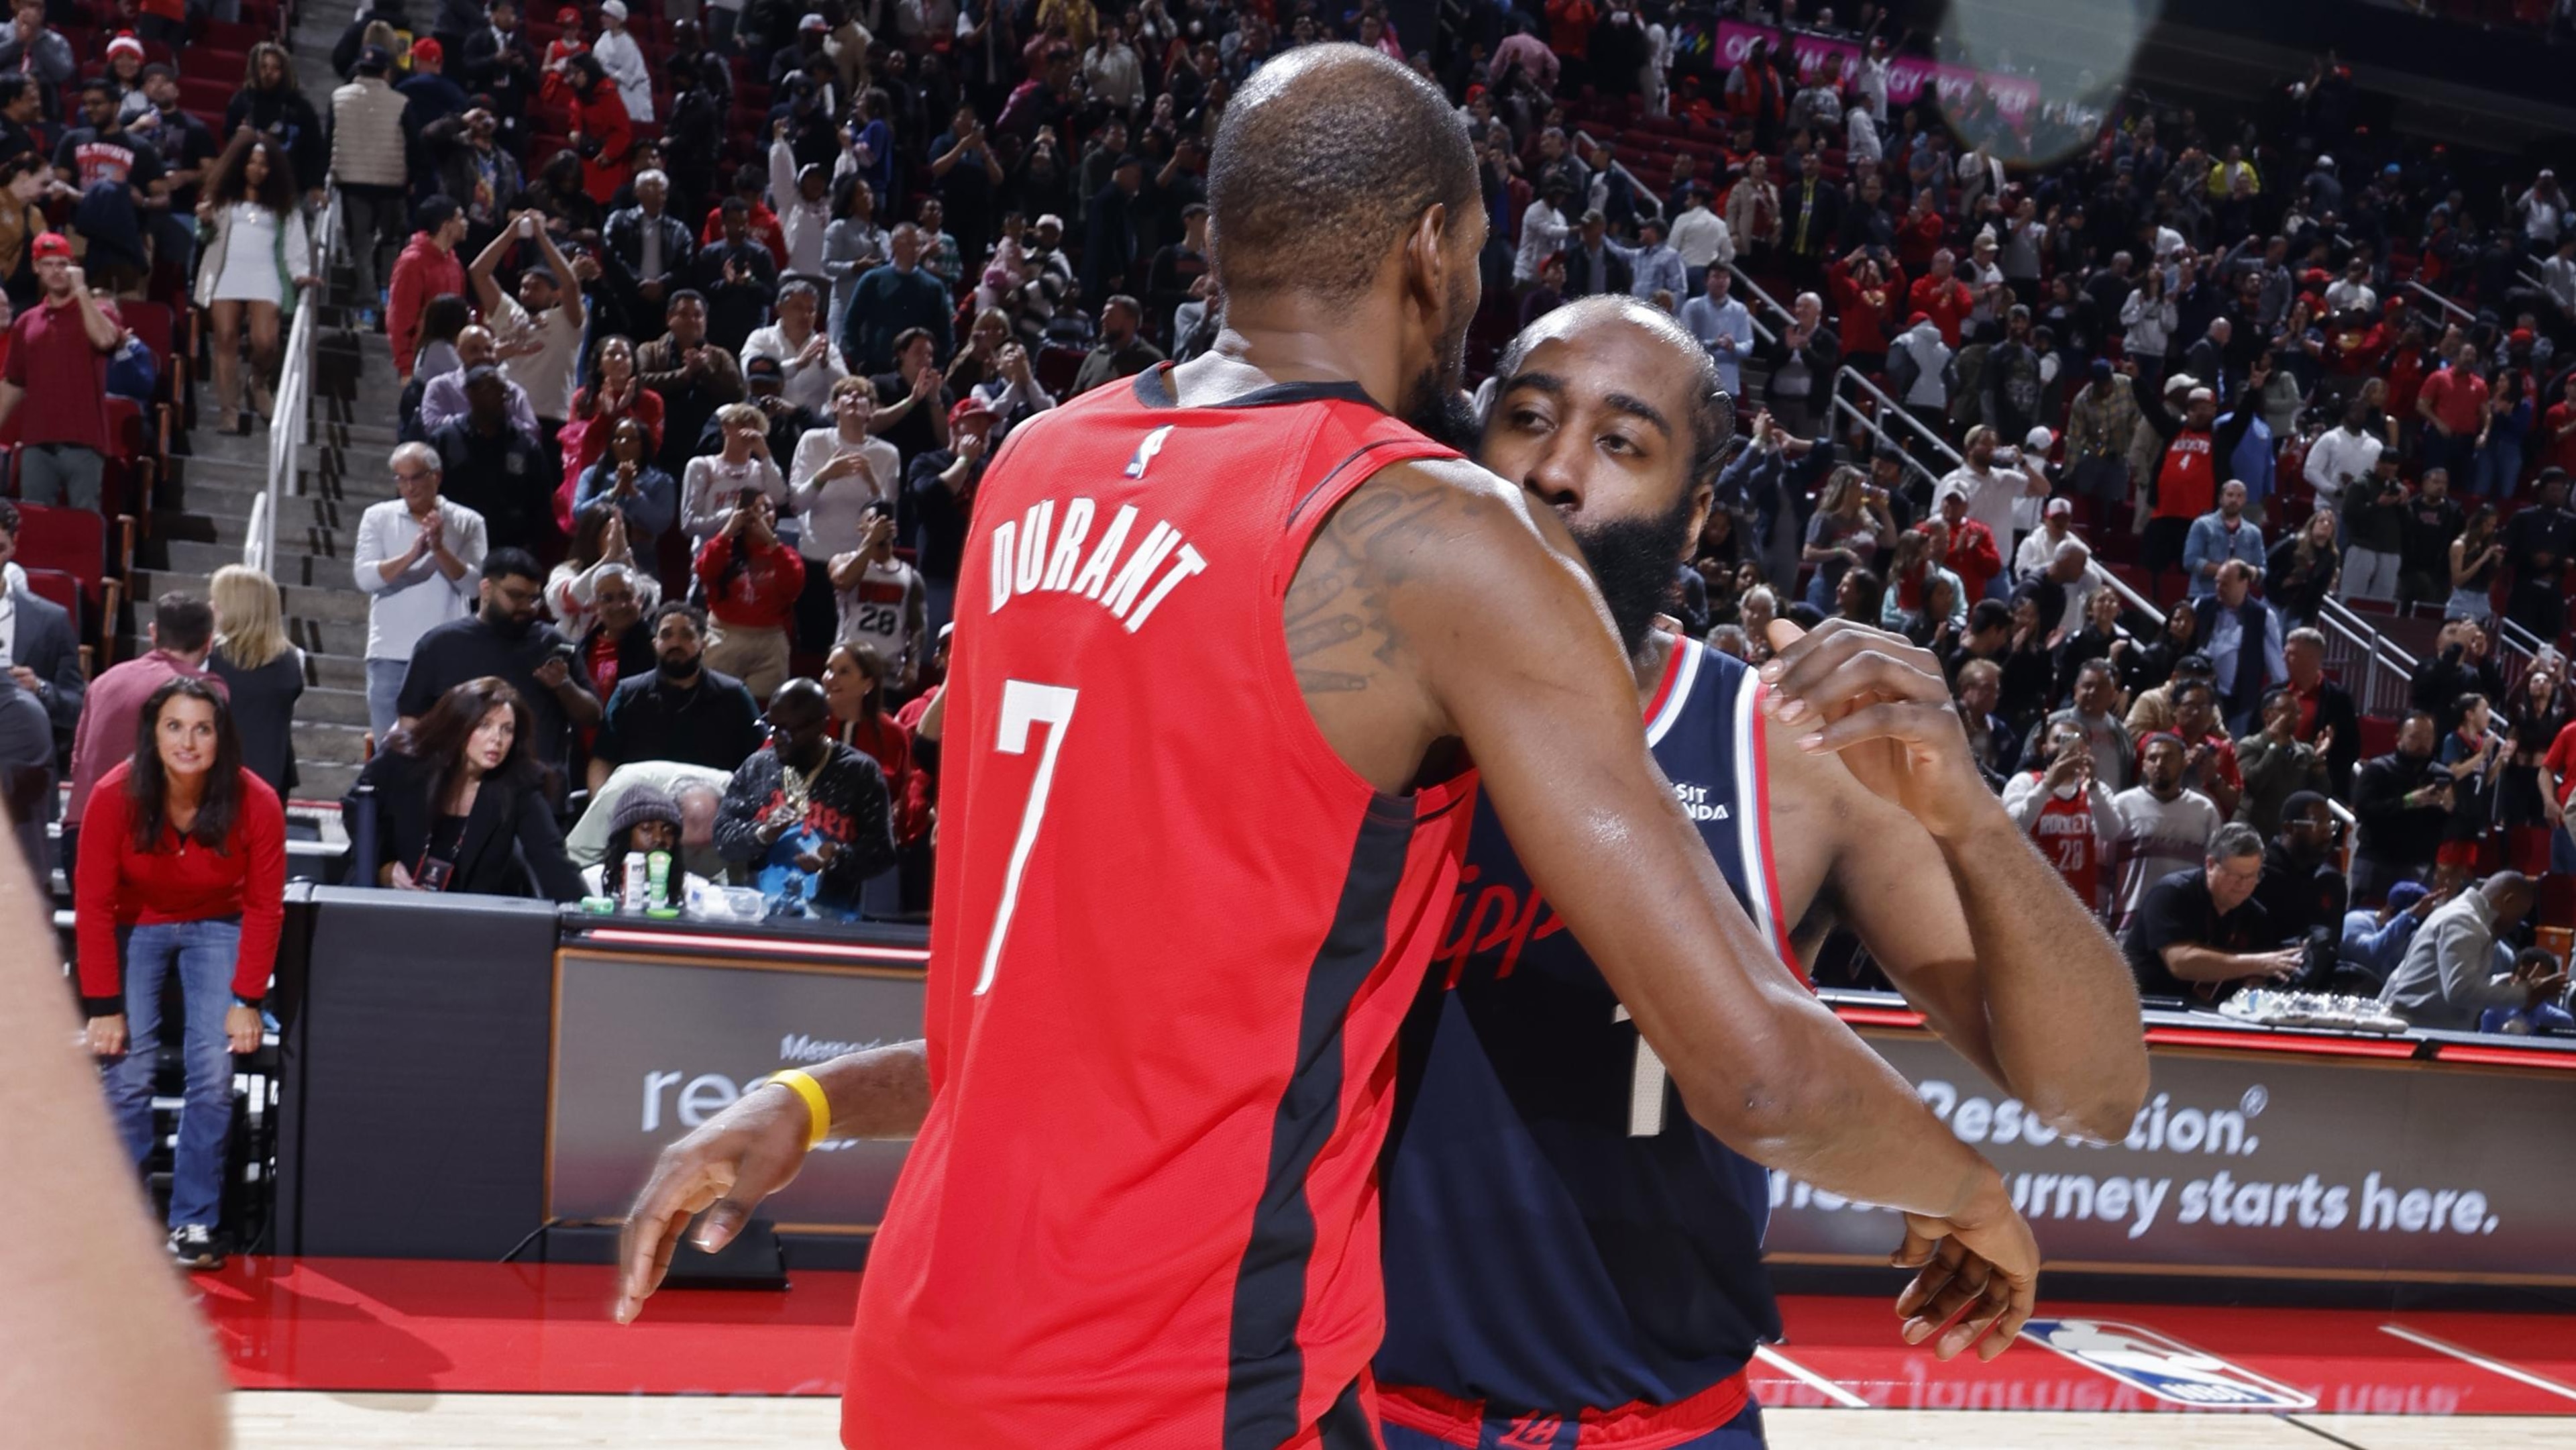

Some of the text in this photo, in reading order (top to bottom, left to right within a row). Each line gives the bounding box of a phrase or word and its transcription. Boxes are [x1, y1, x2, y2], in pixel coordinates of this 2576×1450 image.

[989, 497, 1209, 633] DURANT
[859, 604, 898, 637] 28
[1670, 782, 1708, 804] SIT
[1682, 802, 1729, 821] NDA
[2039, 813, 2090, 835] ROCKET
[973, 678, 1079, 996] 7
[2177, 1169, 2350, 1230] starts
[2357, 1170, 2500, 1236] here.
